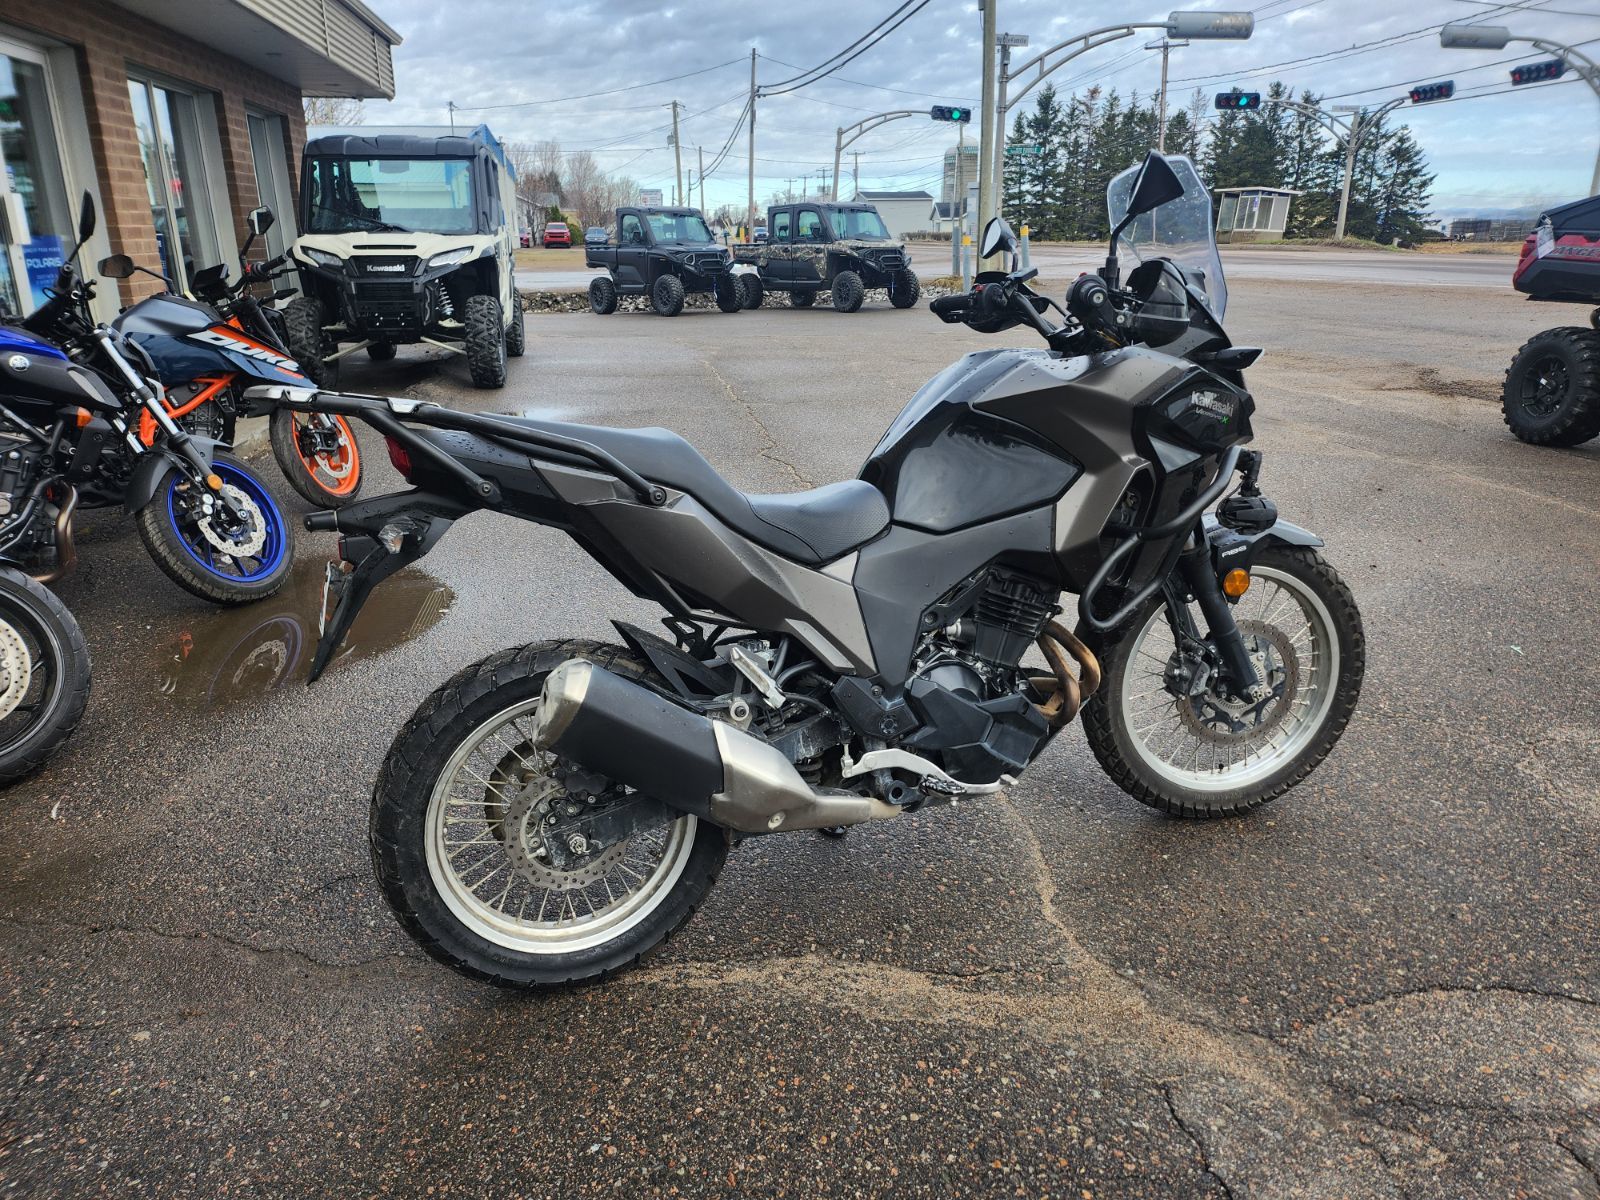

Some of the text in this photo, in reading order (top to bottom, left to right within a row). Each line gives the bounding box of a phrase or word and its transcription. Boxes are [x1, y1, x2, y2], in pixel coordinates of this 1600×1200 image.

[26, 256, 63, 269] POLARIS
[366, 264, 406, 272] Kawasaki
[1191, 391, 1234, 417] Kawasaki
